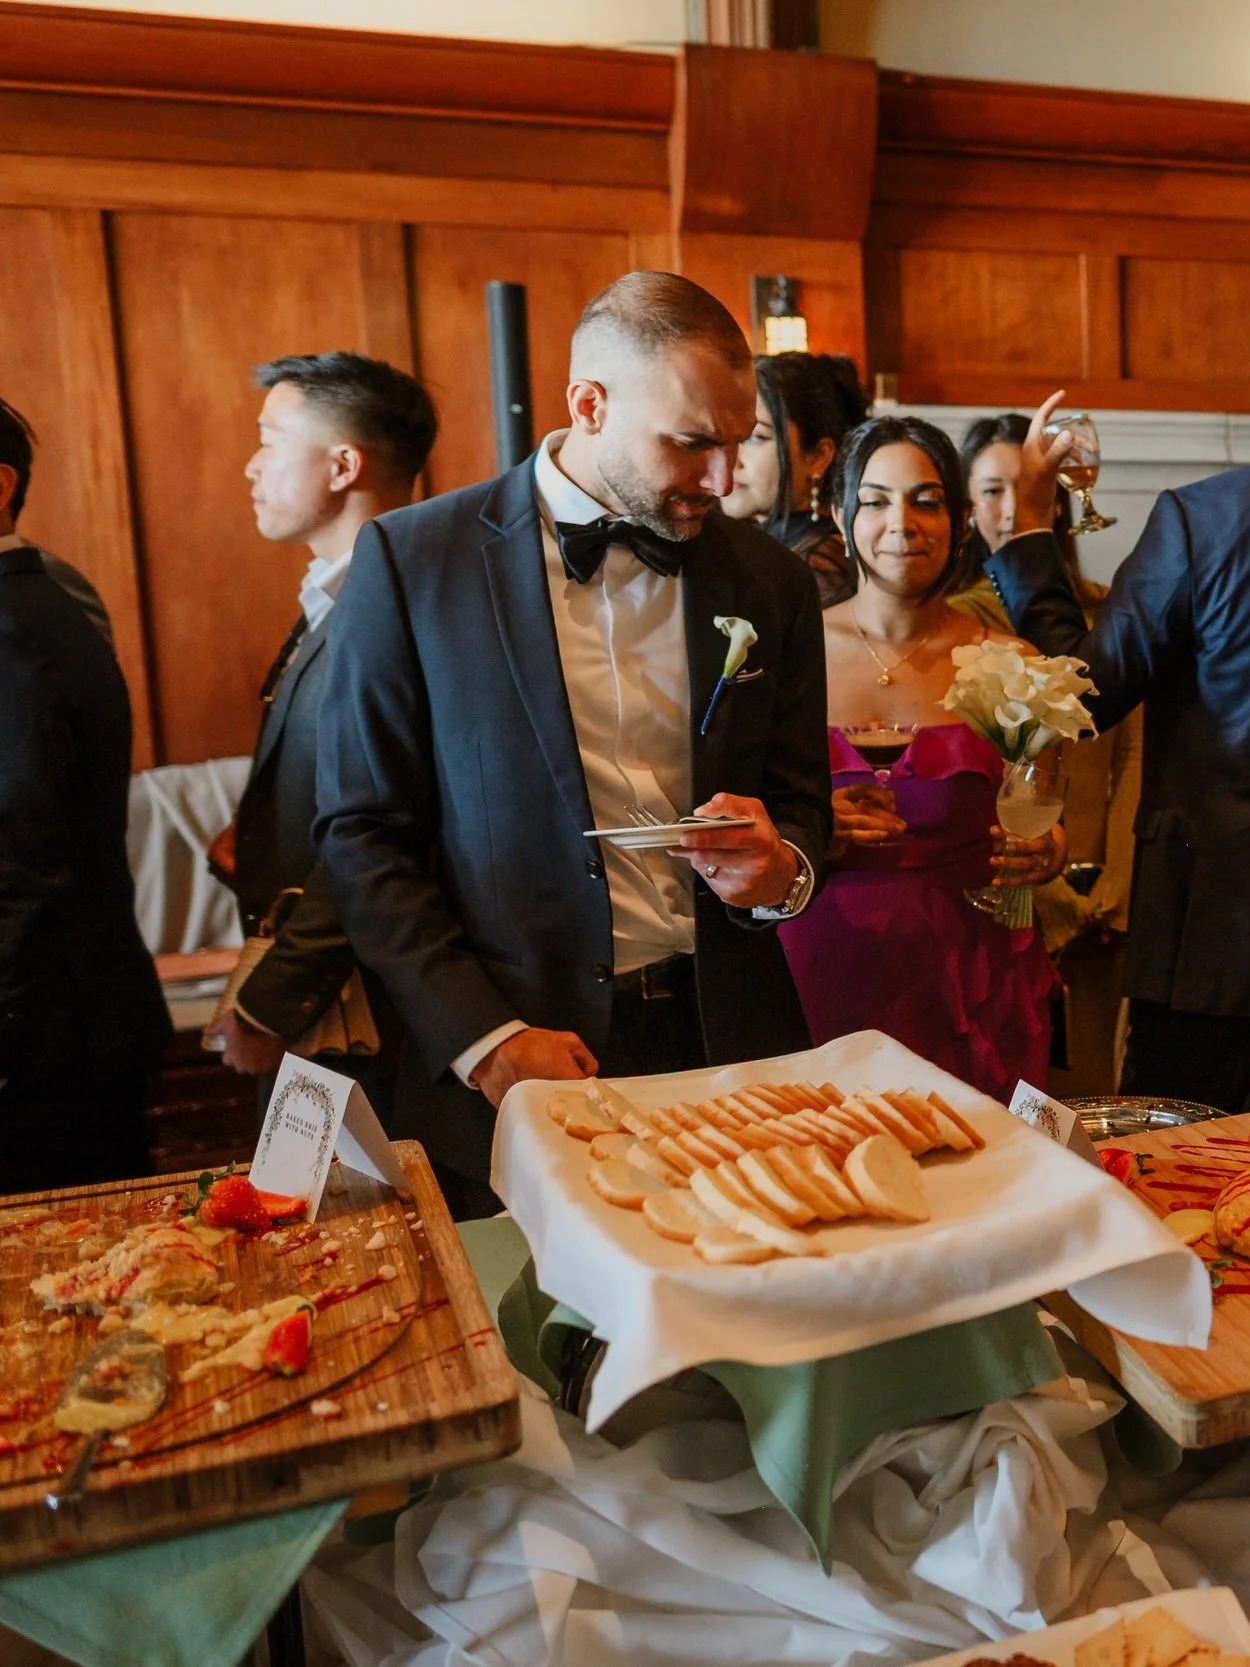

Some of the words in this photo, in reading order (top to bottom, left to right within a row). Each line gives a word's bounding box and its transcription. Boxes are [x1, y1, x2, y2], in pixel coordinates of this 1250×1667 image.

[285, 1122, 299, 1133] WITH
[300, 1129, 314, 1140] NUTS
[286, 1113, 304, 1125] BAKED
[305, 1121, 318, 1132] BRIE
